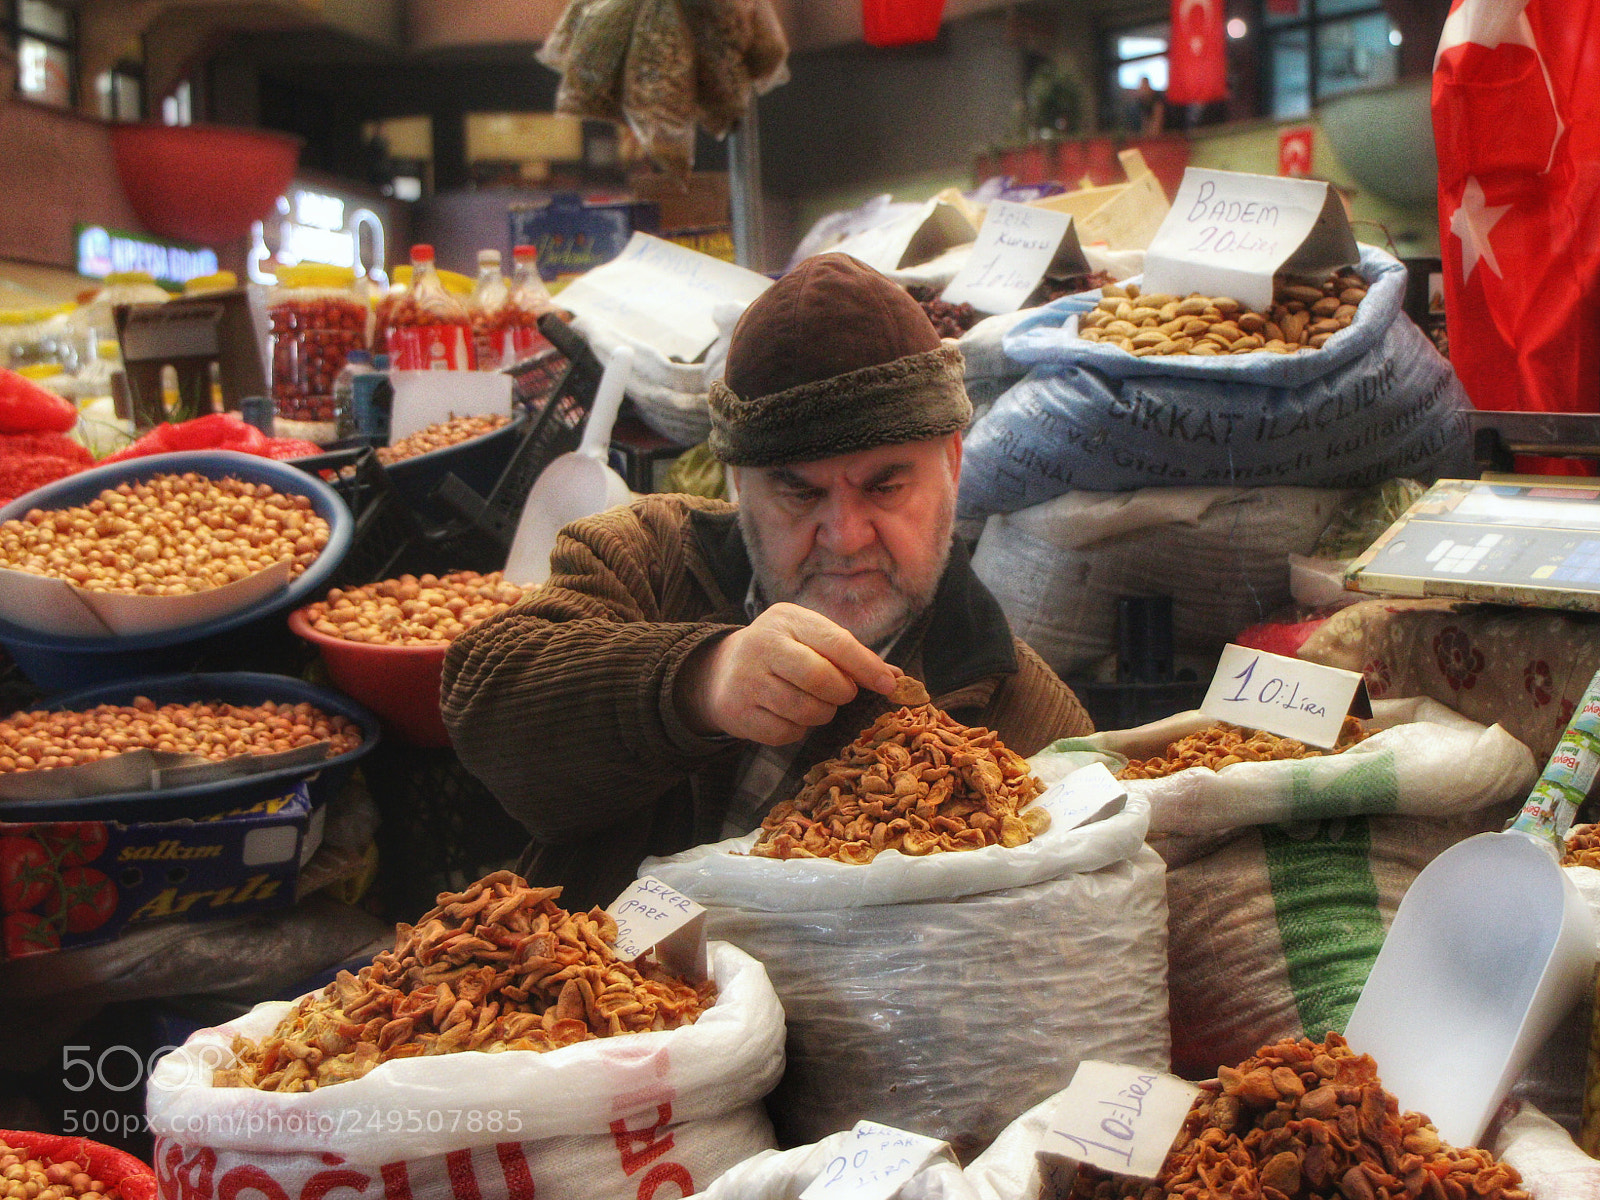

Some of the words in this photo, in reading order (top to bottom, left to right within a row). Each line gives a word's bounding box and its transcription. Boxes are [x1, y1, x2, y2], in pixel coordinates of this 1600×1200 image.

[1187, 181, 1279, 227] BADEM
[617, 899, 669, 921] PARE
[636, 879, 692, 914] ŞEKER
